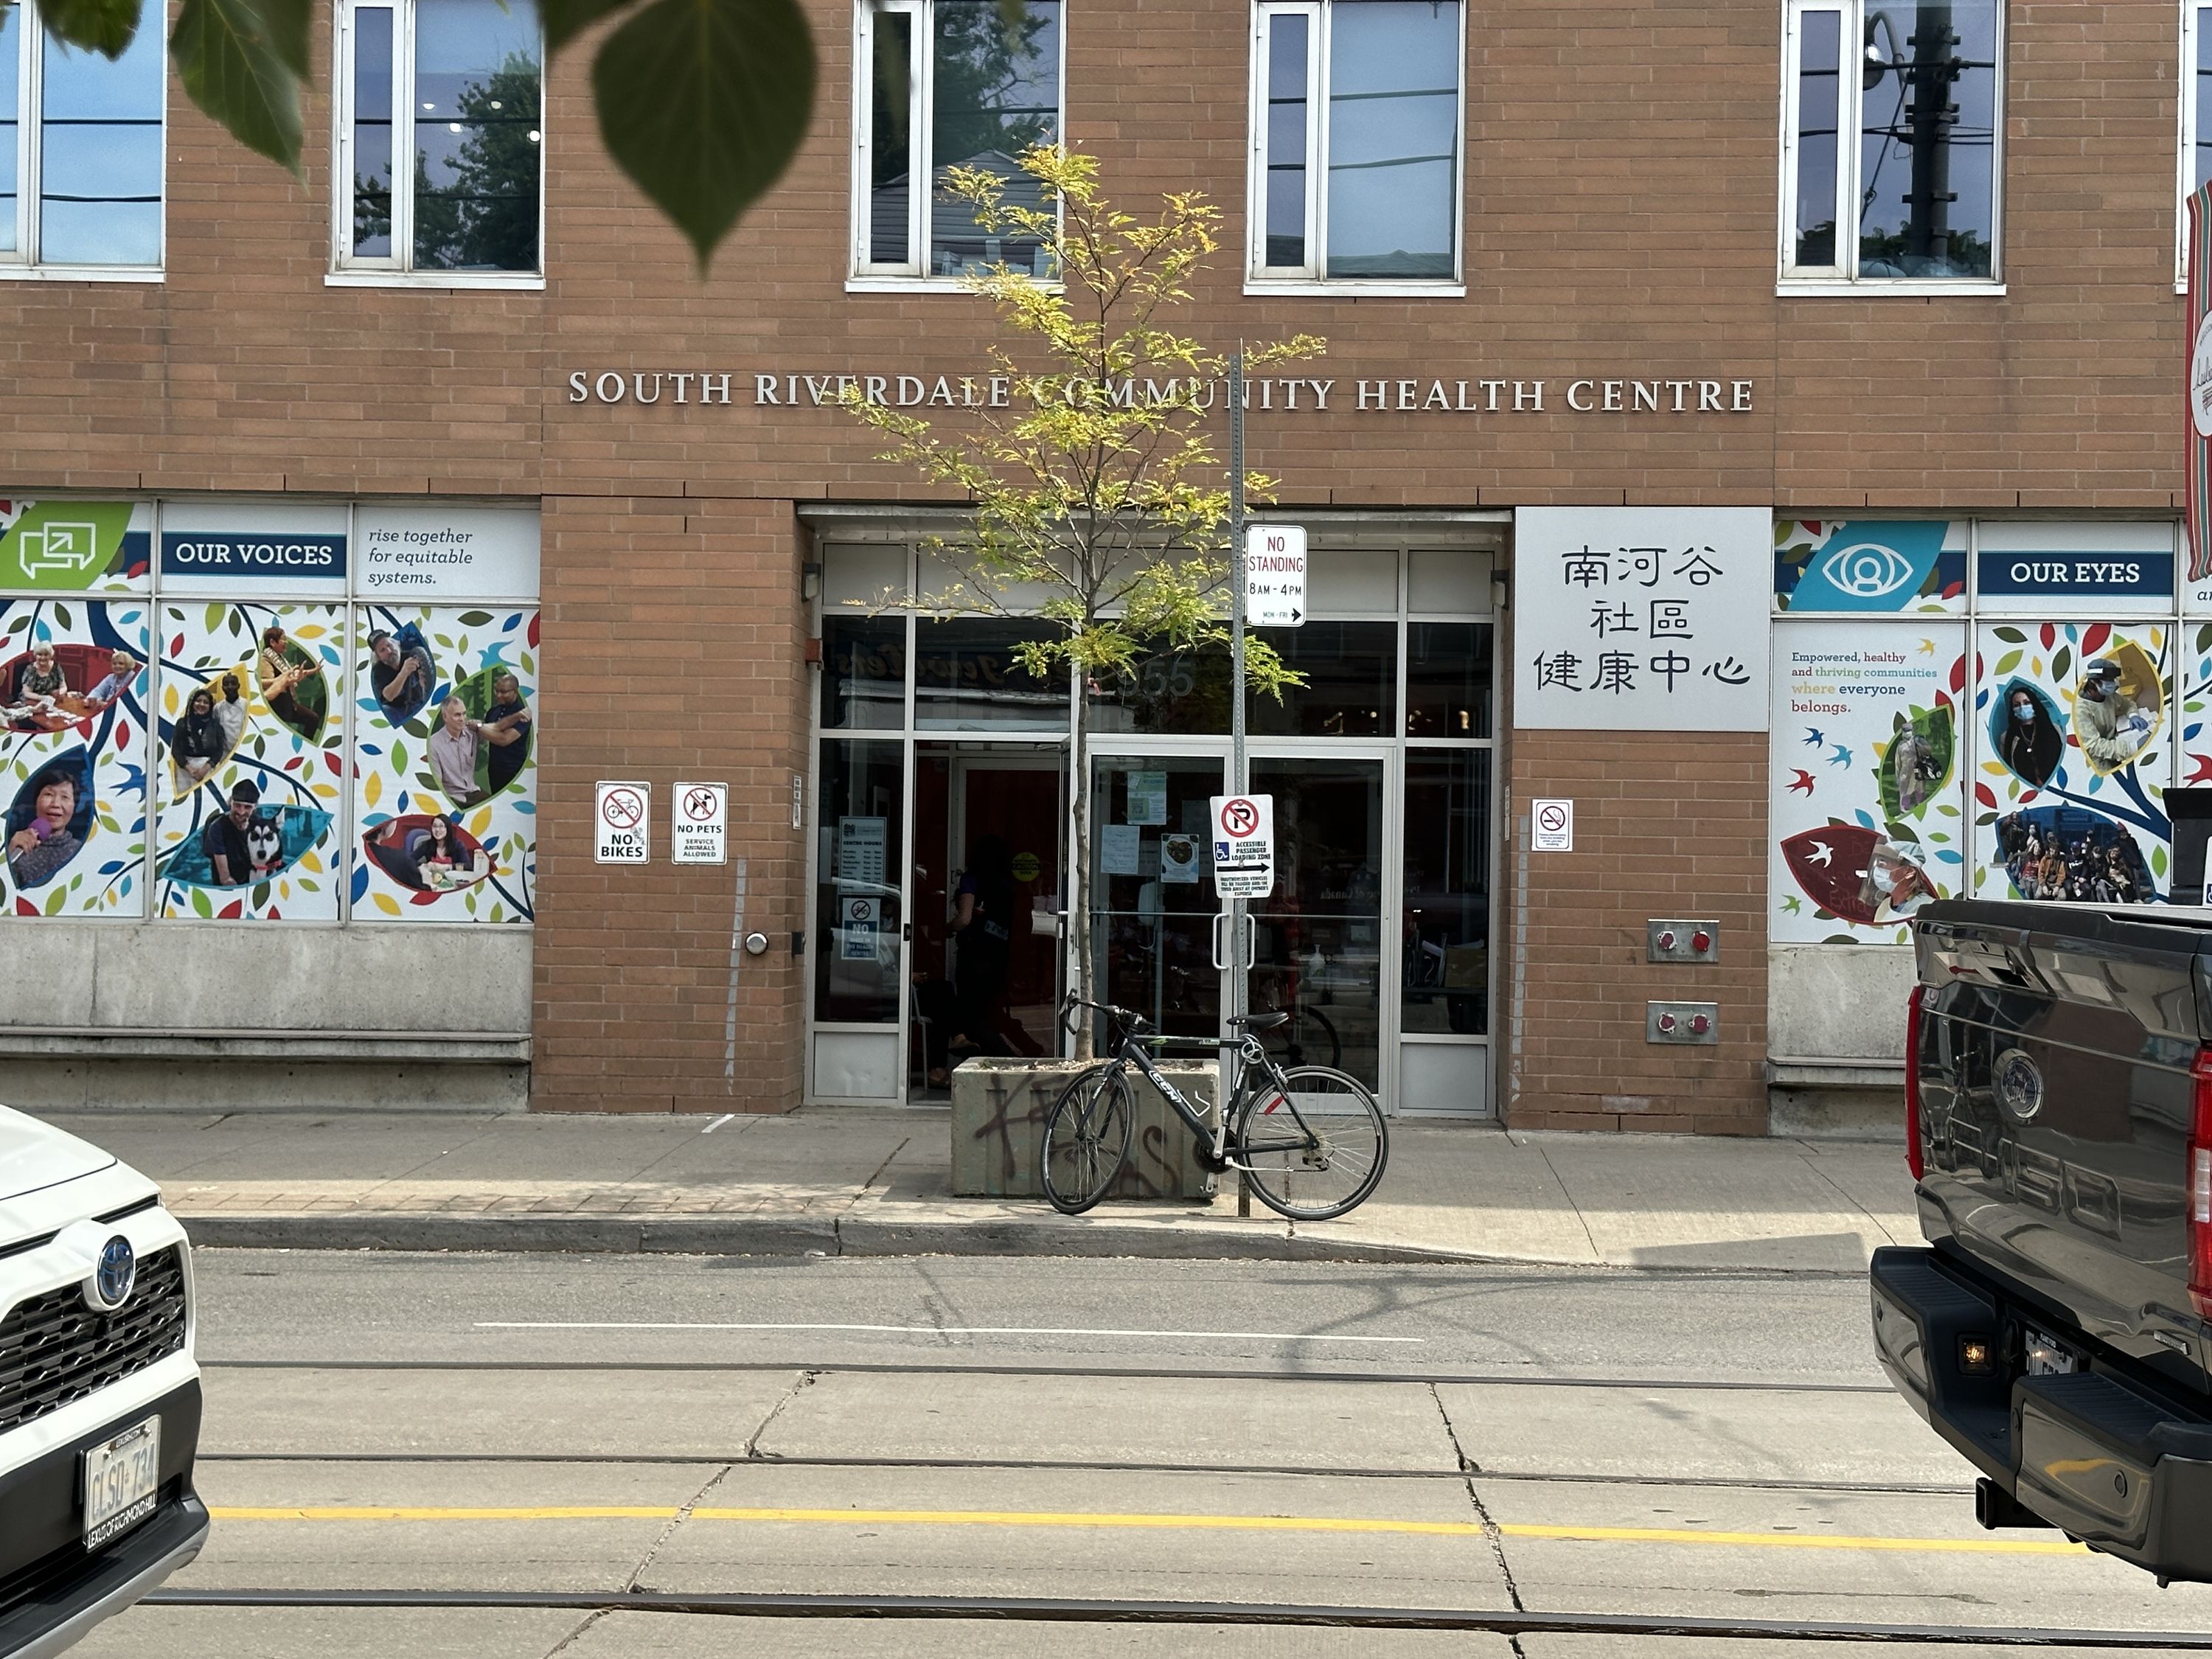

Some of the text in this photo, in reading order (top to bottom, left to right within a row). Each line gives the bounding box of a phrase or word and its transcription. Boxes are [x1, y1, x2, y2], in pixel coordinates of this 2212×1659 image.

[568, 371, 1753, 411] SOUTH RIVERDALE COMMUNITY HEALTH CENTRE
[369, 527, 473, 546] rise together
[1267, 536, 1284, 552] NO
[175, 543, 332, 565] OUR VOICES
[369, 547, 473, 566] for equitable
[1249, 556, 1303, 572] STANDING
[1562, 545, 1723, 588] 南河谷
[368, 572, 437, 587] systems.
[2011, 562, 2140, 583] OUR EYES
[1590, 600, 1694, 639] 社區
[1792, 652, 1906, 664] Empowered, healthy
[1533, 650, 1750, 695] 健康中心
[1792, 667, 1937, 679] and thriving communities
[1791, 682, 1905, 698] where everyone
[1791, 700, 1851, 715] belongs.
[678, 825, 722, 833] NO PETS
[611, 834, 633, 845] NO
[601, 846, 643, 858] BIKES
[852, 923, 869, 935] NO
[1152, 1072, 1178, 1101] CCM
[145, 1492, 155, 1512] HILL
